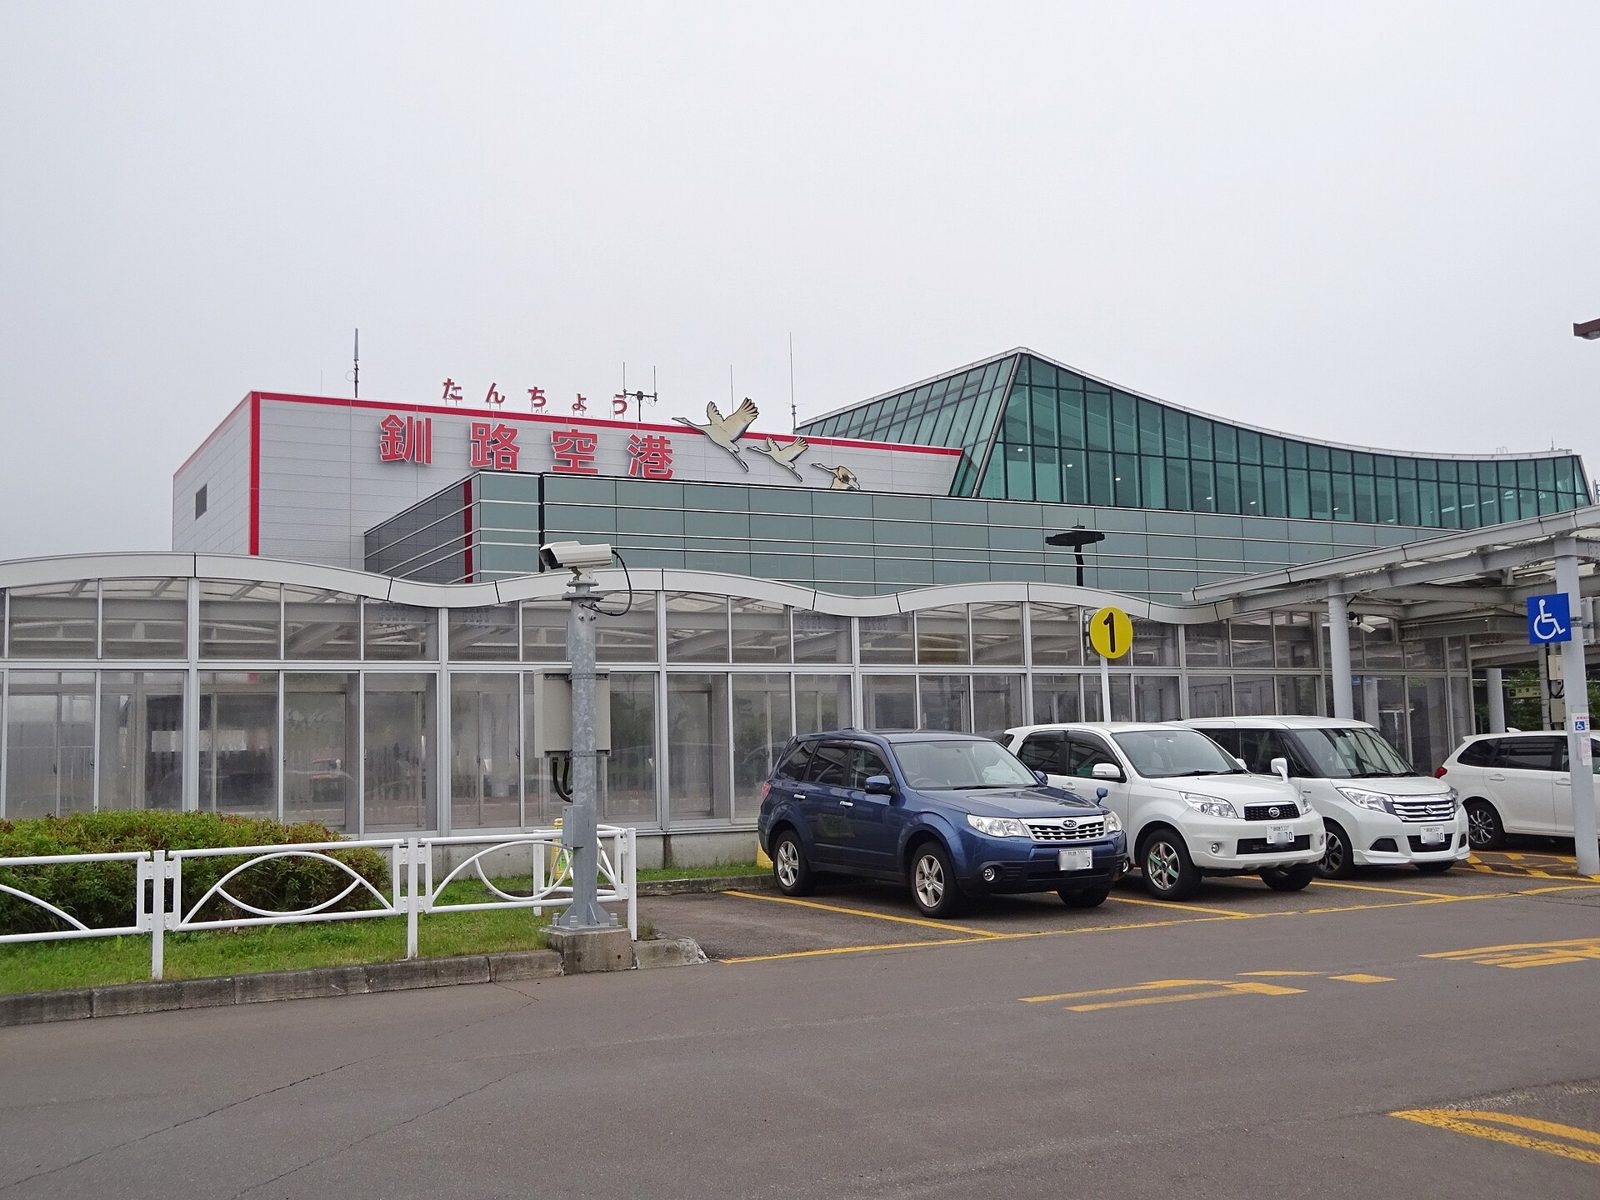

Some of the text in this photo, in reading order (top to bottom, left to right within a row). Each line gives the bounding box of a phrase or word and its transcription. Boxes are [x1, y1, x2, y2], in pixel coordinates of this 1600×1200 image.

[442, 378, 628, 415] たんちょう
[379, 414, 674, 480] 釧路空港
[1103, 612, 1116, 653] 1
